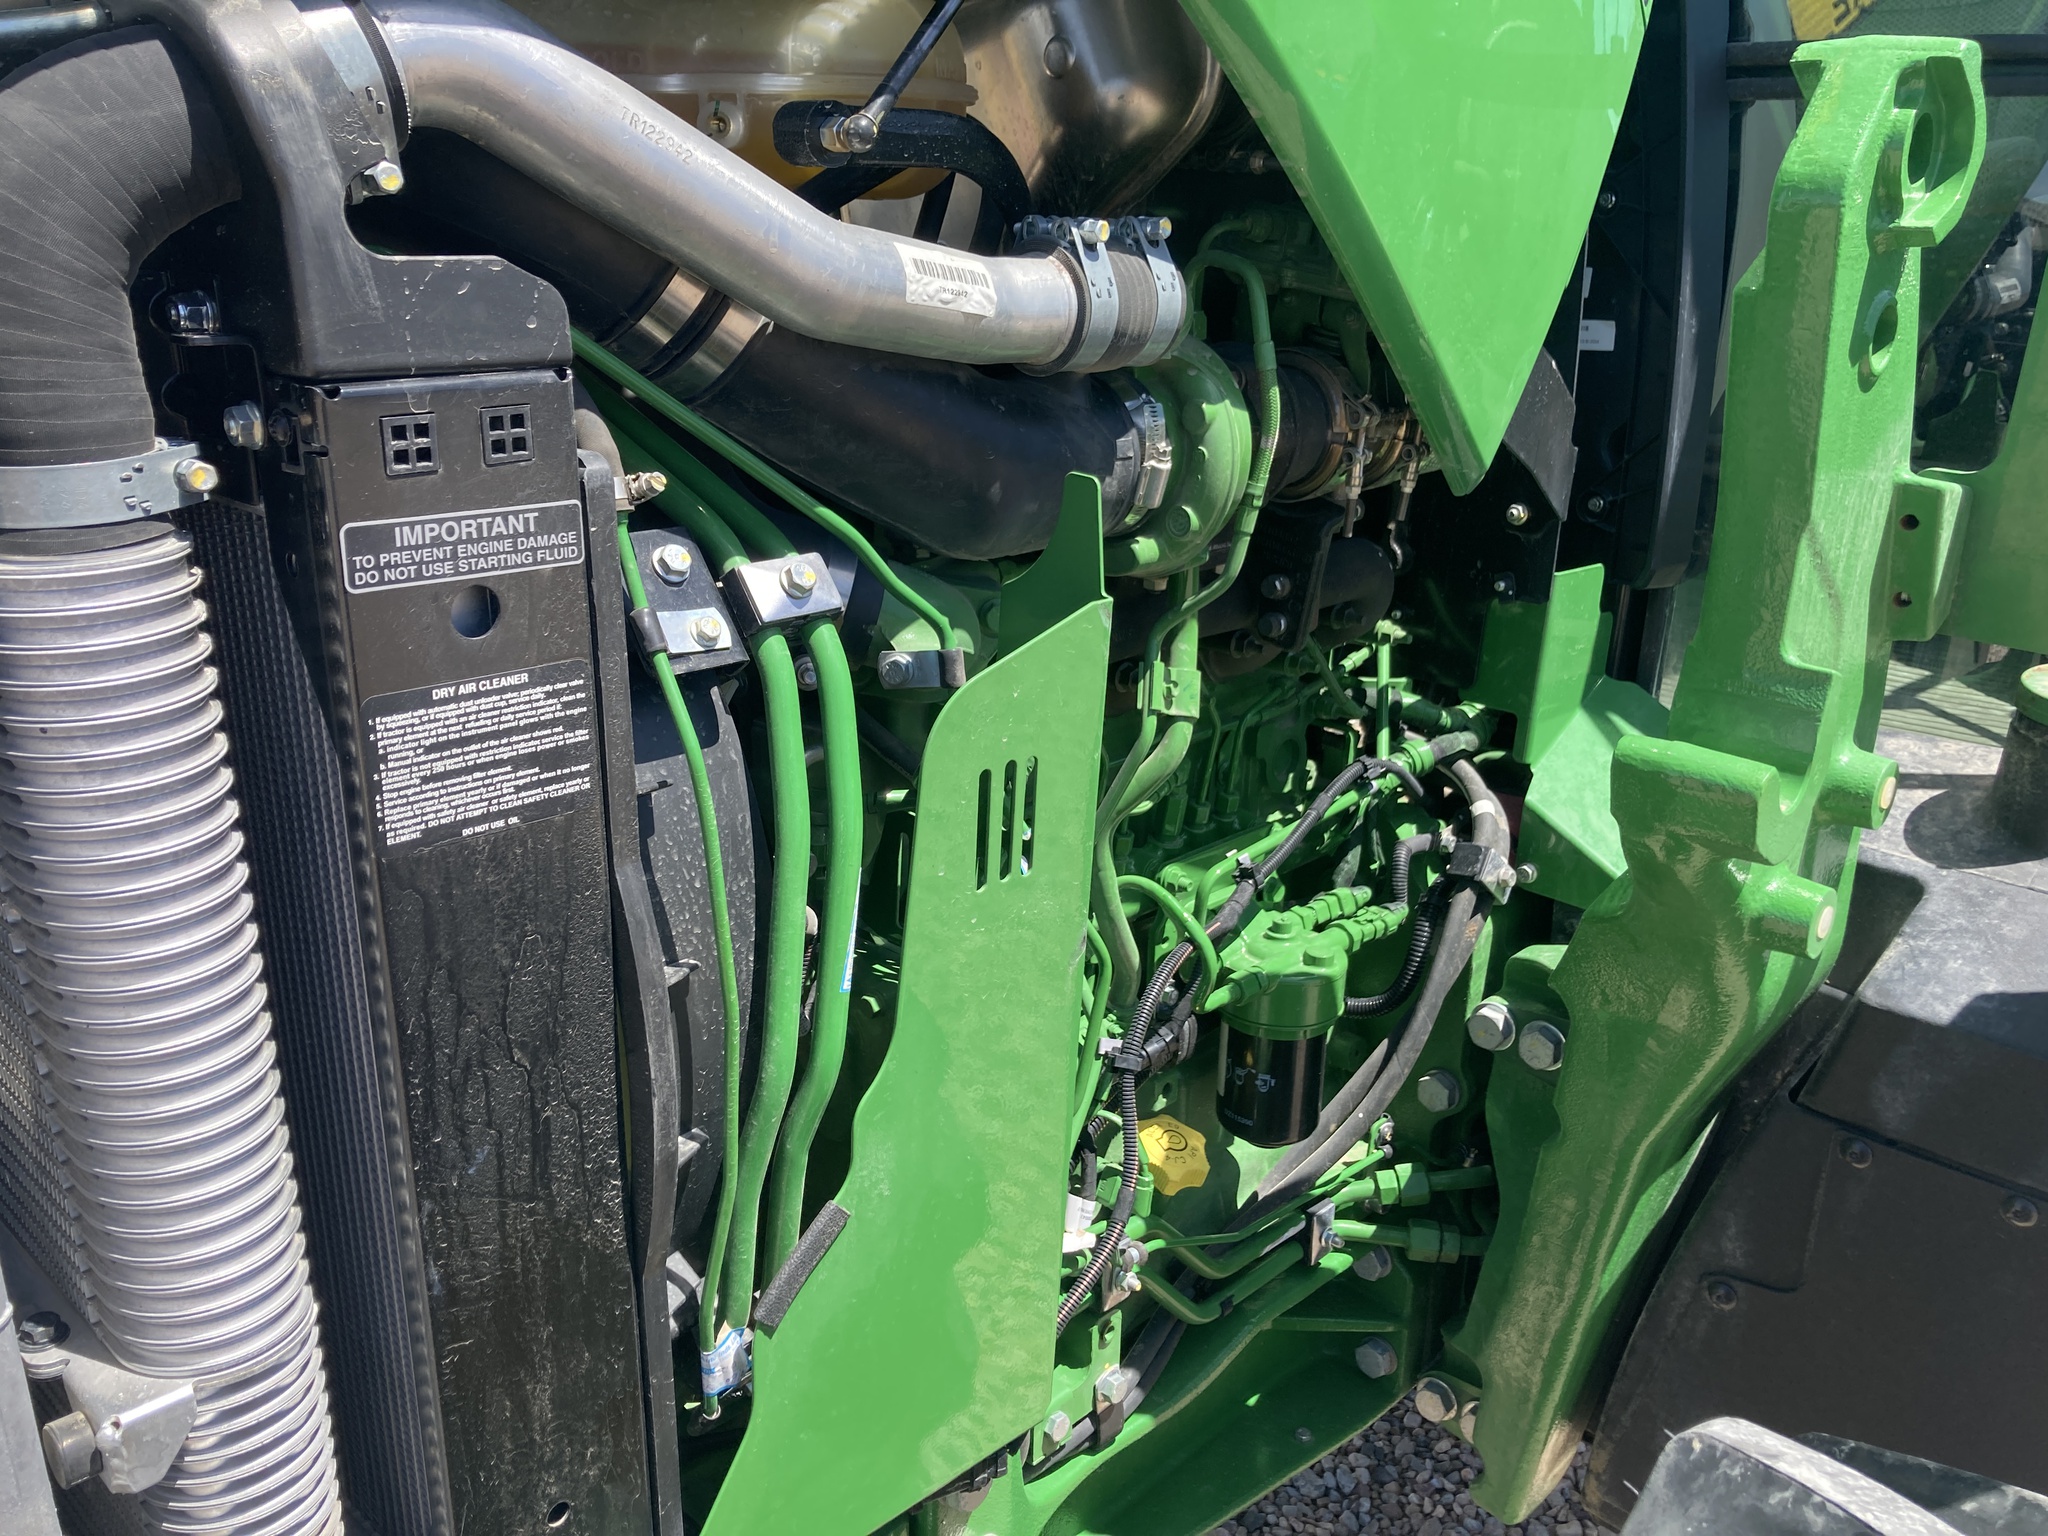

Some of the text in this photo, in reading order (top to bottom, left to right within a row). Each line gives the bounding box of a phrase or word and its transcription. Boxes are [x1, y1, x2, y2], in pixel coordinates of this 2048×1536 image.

[620, 106, 693, 165] TR122942
[395, 513, 539, 548] IMPORTANT
[353, 532, 577, 569] TO PREVENT ENGINE DAMAGE
[355, 546, 578, 586] DO NOT USE STARTING FLUID
[432, 672, 528, 700] DRY AIR CLEANER
[378, 737, 403, 748] primary
[404, 731, 429, 741] element
[449, 724, 462, 732] next
[465, 719, 491, 728] refueling
[516, 710, 536, 718] service
[537, 705, 555, 715] period
[383, 729, 404, 738] tractor
[413, 720, 443, 732] equipped
[444, 717, 458, 725] with
[478, 710, 500, 718] cleaner
[501, 704, 531, 714] restriction
[420, 736, 437, 746] light
[461, 724, 498, 737] instrument
[500, 720, 518, 730] panel
[519, 717, 538, 726] glows
[540, 712, 553, 720] with
[566, 707, 587, 715] engine
[382, 773, 410, 784] element
[411, 770, 431, 778] every
[432, 765, 444, 773] 250
[446, 762, 466, 770] hours
[476, 756, 494, 764] when
[495, 751, 517, 759] engine
[537, 742, 556, 752] power
[566, 735, 589, 744] smokes
[387, 758, 411, 768] Manual
[412, 753, 441, 763] indicator
[463, 743, 481, 752] outlet
[510, 733, 532, 742] cleaner
[532, 729, 551, 737] shows
[388, 768, 411, 777] tractor
[420, 762, 431, 770] not
[432, 755, 463, 768] equipped
[464, 752, 478, 760] with
[479, 746, 512, 757] restriction
[542, 735, 563, 743] service
[383, 798, 407, 807] Service
[408, 791, 439, 802] according
[448, 781, 483, 792] instructions
[493, 773, 515, 784] primary
[384, 805, 412, 816] Replace
[413, 799, 438, 811] primary
[440, 791, 466, 802] element
[467, 787, 487, 798] yearly
[502, 776, 530, 788] damaged
[391, 816, 421, 829] equipped
[422, 812, 436, 821] with
[437, 808, 456, 817] safety
[466, 801, 489, 810] cleaner
[499, 794, 517, 802] safety
[544, 783, 564, 792] replace
[566, 778, 582, 788] yearly
[399, 787, 421, 796] engine
[422, 782, 442, 790] before
[443, 775, 472, 786] removing
[396, 823, 426, 835] required.
[440, 816, 455, 824] NOT
[456, 808, 487, 820] ATTEMPT
[500, 799, 522, 810] CLEAN
[523, 793, 549, 804] SAFETY
[550, 785, 580, 797] CLEANER
[475, 822, 489, 832] NOT
[490, 819, 505, 829] USE
[508, 815, 520, 824] OIL
[387, 832, 422, 845] ELEMENT.
